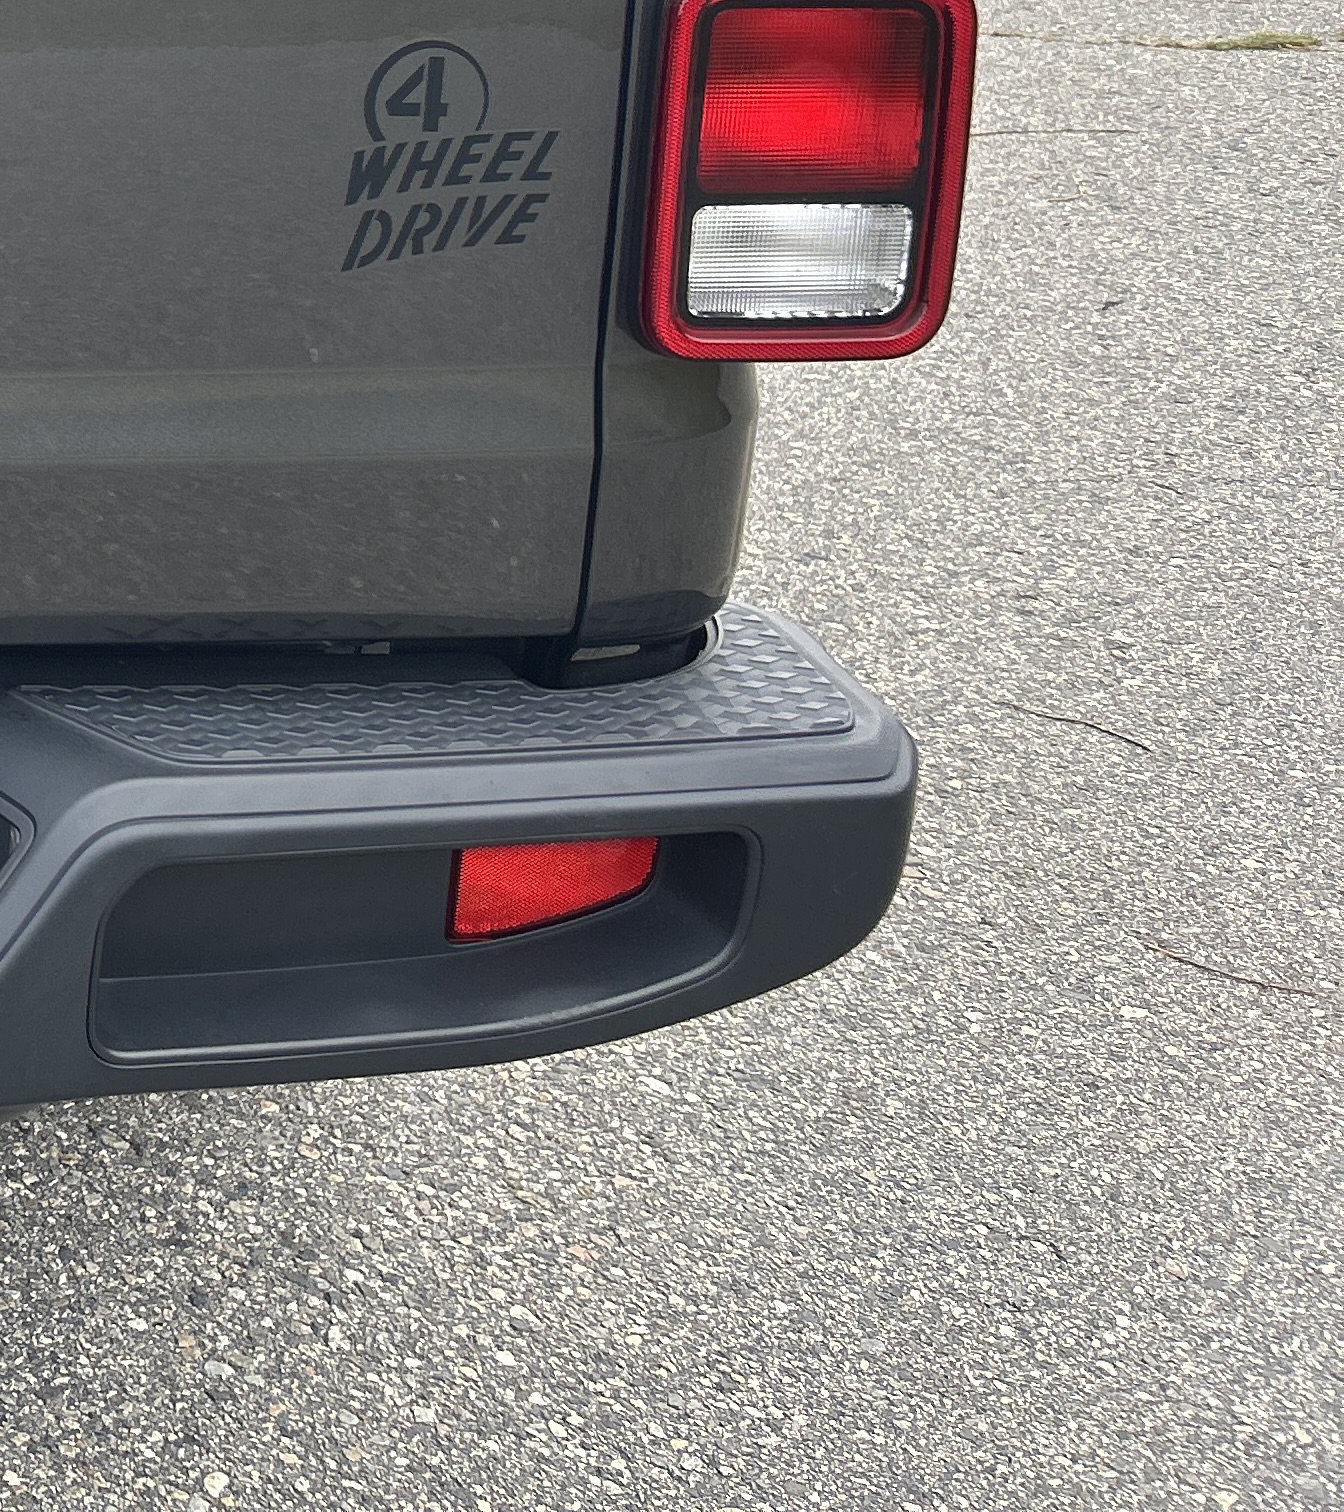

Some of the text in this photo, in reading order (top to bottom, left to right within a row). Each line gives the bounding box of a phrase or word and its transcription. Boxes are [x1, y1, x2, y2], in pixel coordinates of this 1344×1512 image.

[385, 56, 449, 132] 4
[343, 130, 561, 207] WHEEL
[340, 193, 551, 272] DRIVE
